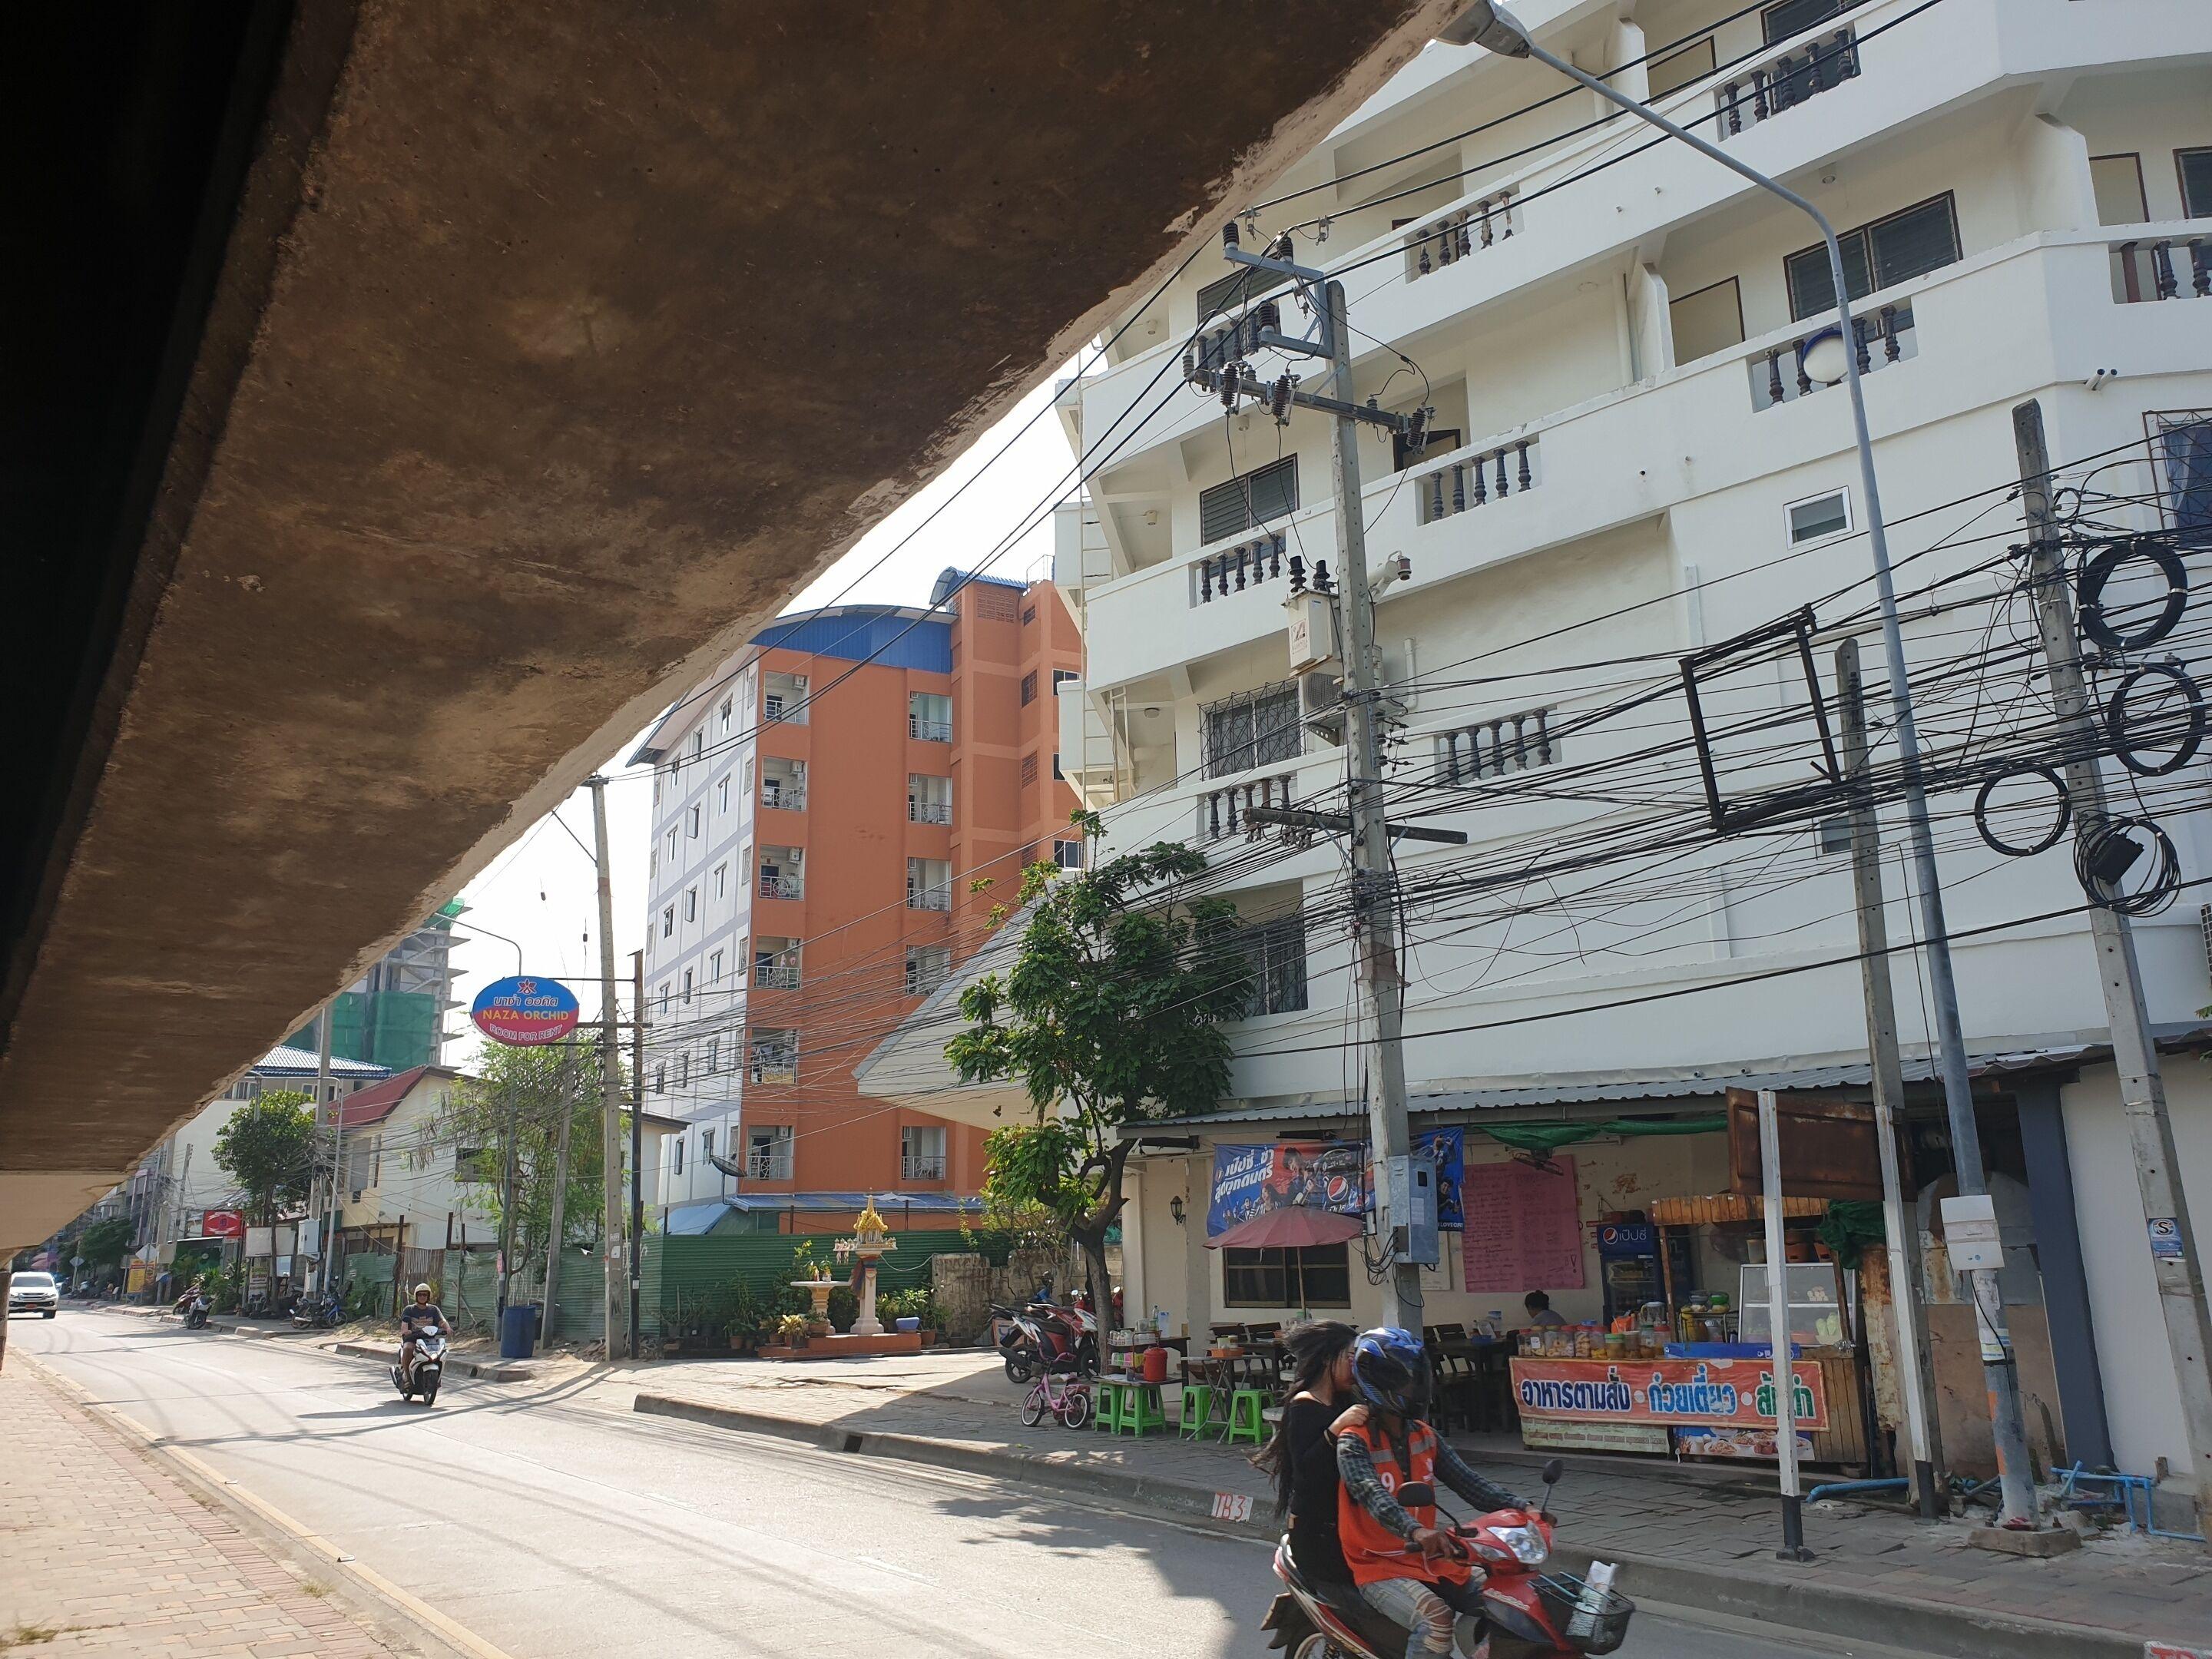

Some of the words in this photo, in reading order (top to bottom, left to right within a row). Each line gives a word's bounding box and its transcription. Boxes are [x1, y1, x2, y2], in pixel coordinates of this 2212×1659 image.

[482, 1010, 519, 1020] NAZA
[523, 1010, 569, 1021] ORCHID
[489, 1023, 517, 1040] ROOM
[518, 1032, 538, 1041] FOR
[538, 1025, 563, 1040] RENT
[1521, 1366, 1631, 1412] อาหารตามสั่ง
